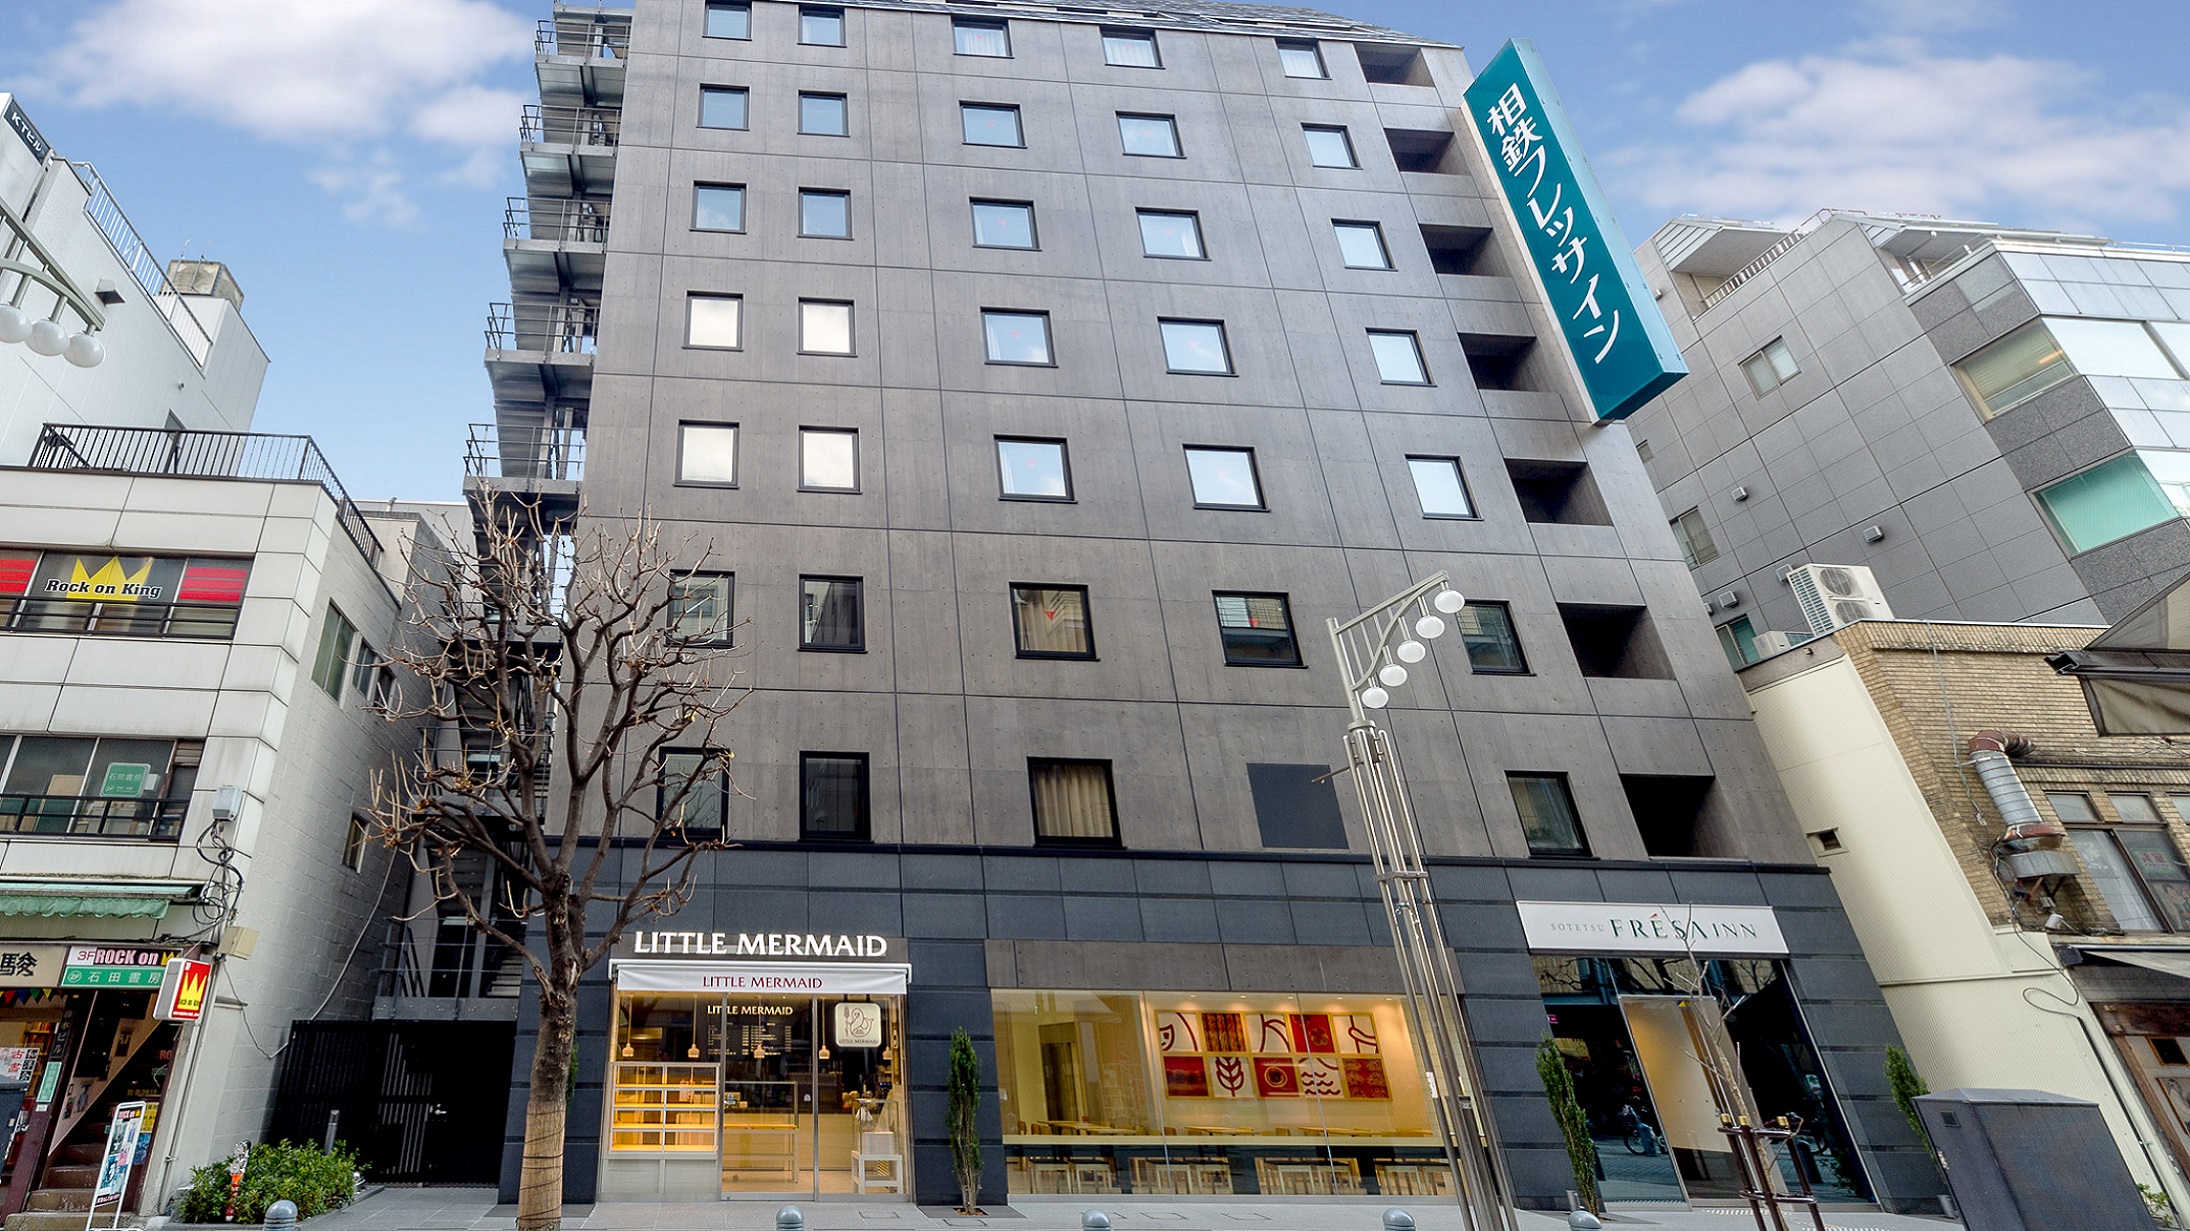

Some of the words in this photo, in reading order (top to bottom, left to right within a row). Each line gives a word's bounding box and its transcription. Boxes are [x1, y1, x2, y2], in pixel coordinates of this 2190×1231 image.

[1486, 82, 1620, 364] 相鉄フレッサイン
[45, 578, 90, 594] Rock
[94, 584, 115, 595] on
[121, 582, 163, 598] King
[1550, 923, 1604, 932] SOTETSU
[1713, 922, 1758, 938] INN
[634, 931, 728, 955] LITTLE
[736, 933, 888, 957] MERMAID
[77, 950, 95, 961] 3F
[94, 949, 137, 965] ROCK
[138, 952, 159, 965] on
[88, 971, 161, 984] 石田書房
[703, 975, 746, 988] LITTLE
[751, 976, 823, 989] MERMAID
[741, 1005, 794, 1016] MERMAID
